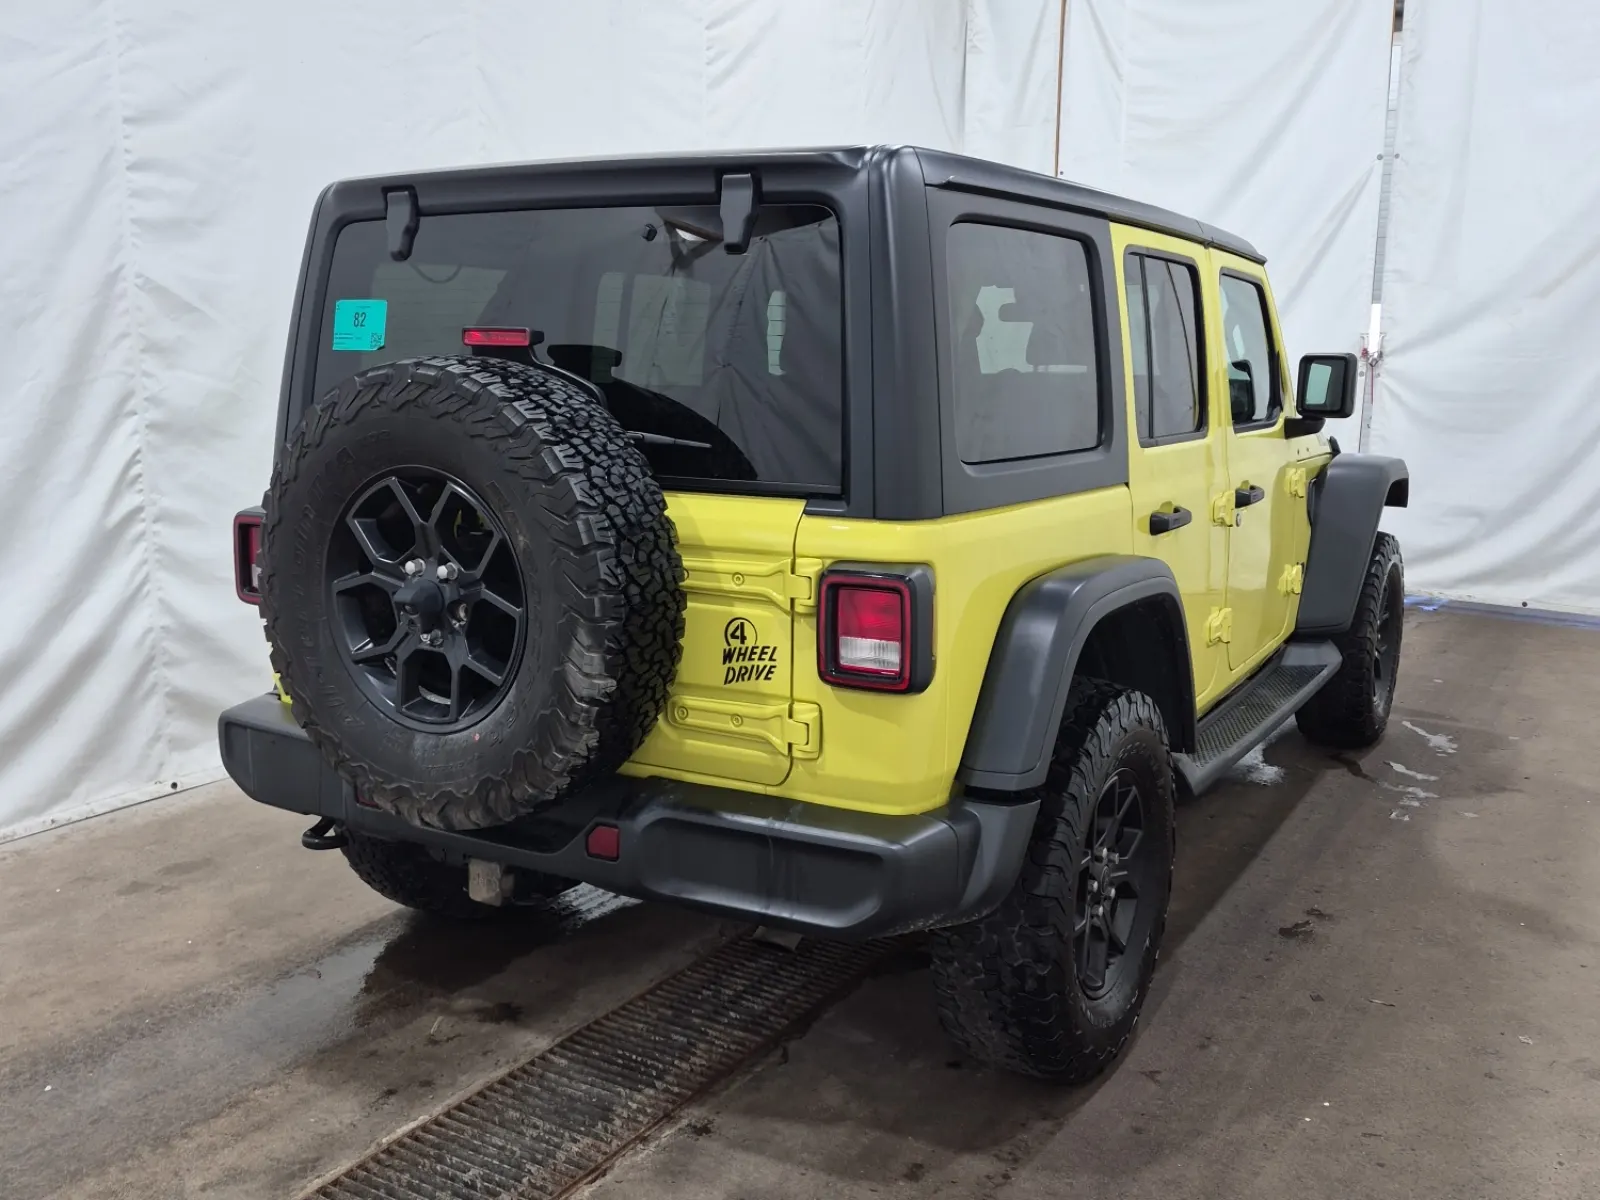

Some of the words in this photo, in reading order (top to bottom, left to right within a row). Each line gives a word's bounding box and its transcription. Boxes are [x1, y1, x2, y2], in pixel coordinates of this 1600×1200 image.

[353, 311, 367, 328] 82
[729, 621, 747, 645] 4
[722, 645, 777, 665] WHEEL
[723, 664, 777, 685] DRIVE
